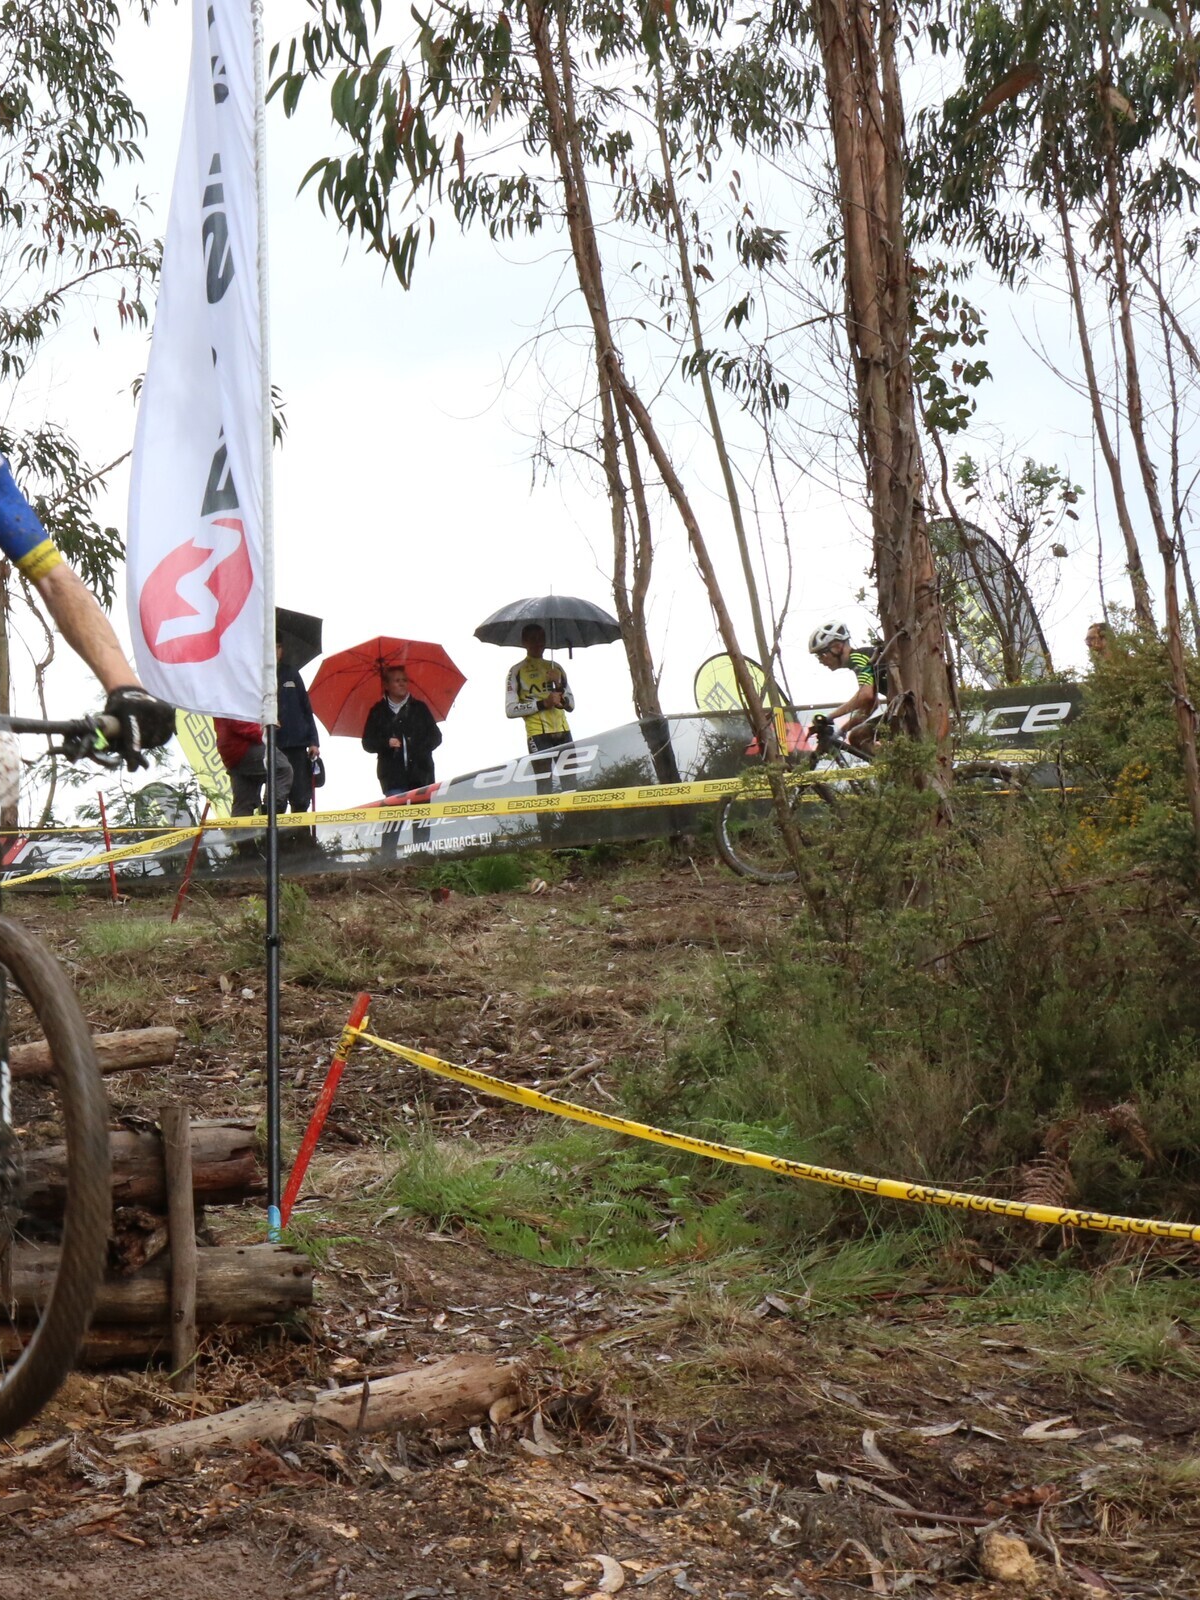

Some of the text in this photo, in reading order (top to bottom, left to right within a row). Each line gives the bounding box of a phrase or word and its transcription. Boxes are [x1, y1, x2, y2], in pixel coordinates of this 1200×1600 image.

[403, 832, 493, 854] WWW.NEWRACE.EU
[906, 1184, 1030, 1218] X-SAUCE
[1058, 1208, 1194, 1240] X-SAUCE
